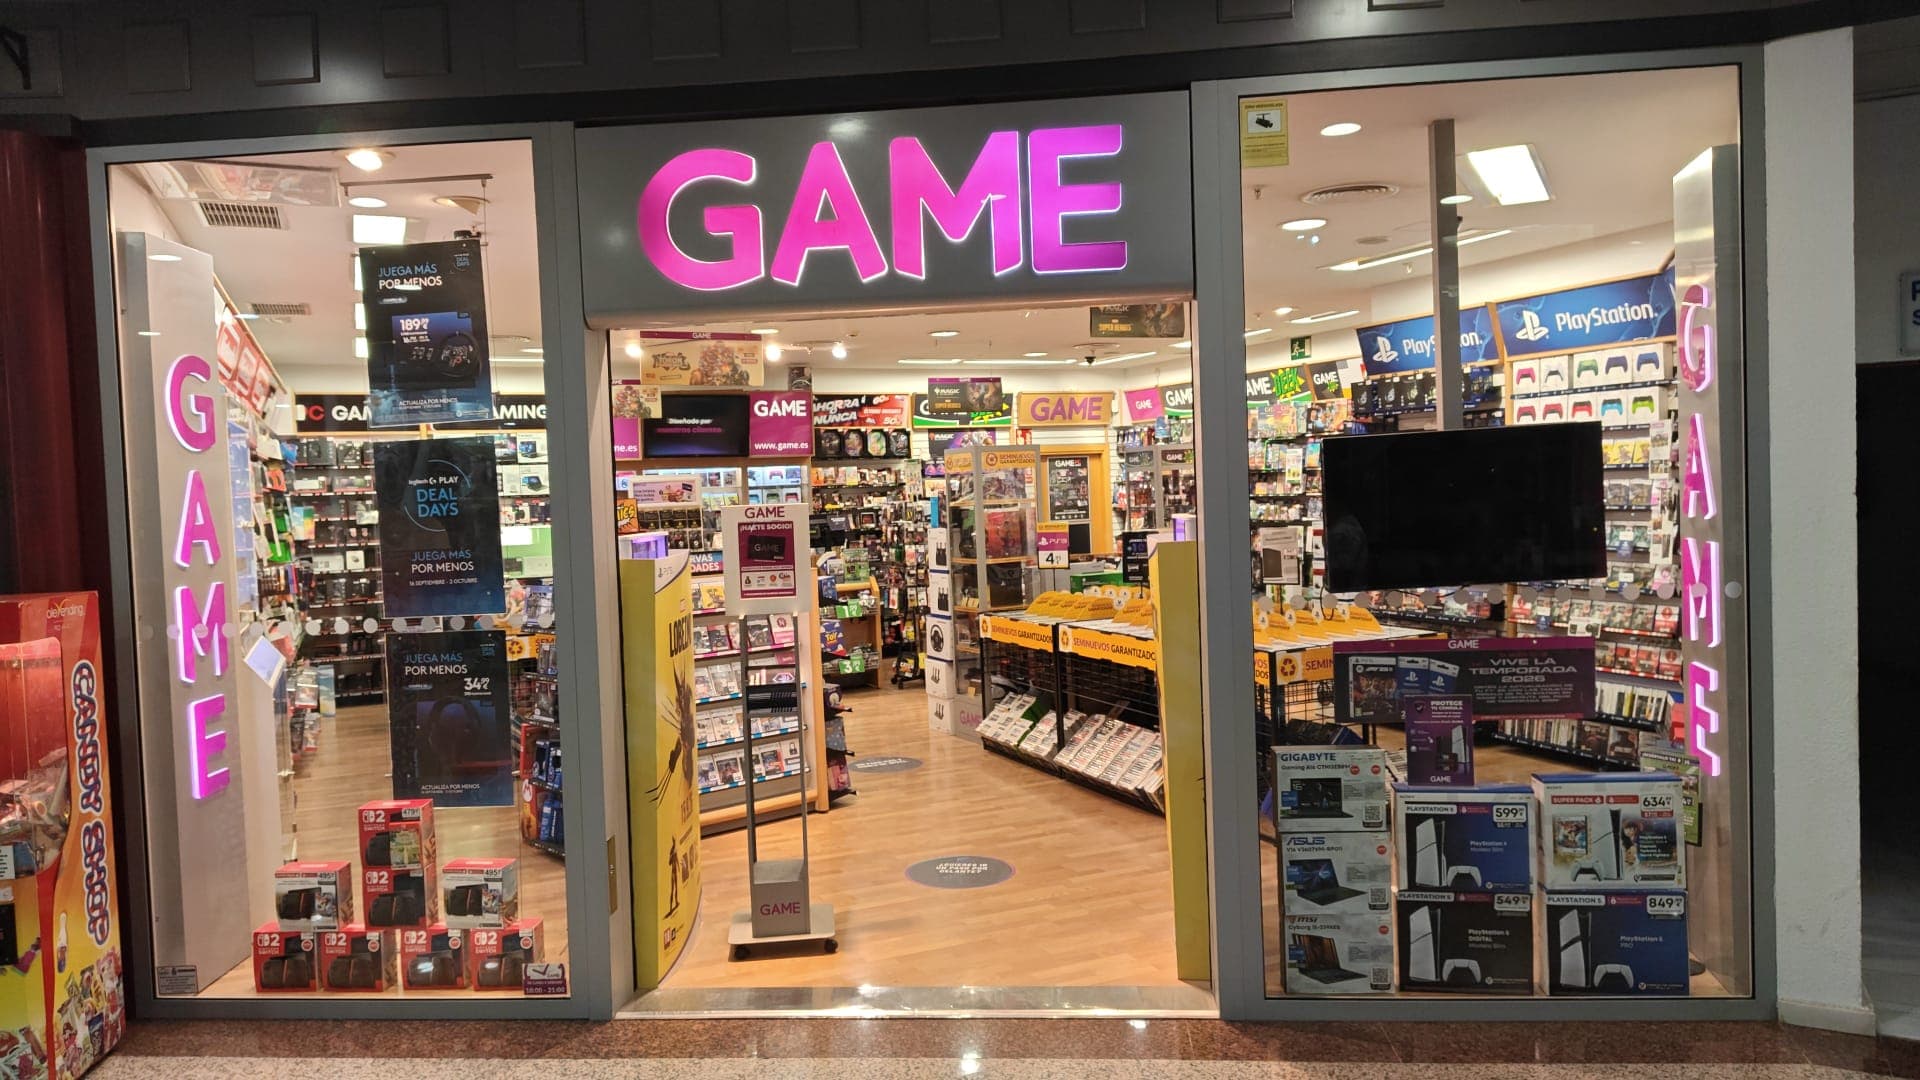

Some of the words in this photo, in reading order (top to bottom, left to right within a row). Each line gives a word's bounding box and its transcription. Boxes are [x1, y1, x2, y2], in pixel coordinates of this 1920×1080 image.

[637, 124, 1128, 291] GAME
[379, 265, 413, 277] JUEGA
[415, 261, 437, 274] MÁS
[403, 276, 443, 289] MENOS
[1313, 371, 1339, 385] GAME
[753, 400, 807, 417] GAME
[1030, 396, 1103, 421] GAME
[1135, 399, 1152, 409] GAME
[814, 411, 858, 425] NUNCA
[754, 441, 809, 451] www.game.es
[1055, 459, 1075, 467] GAME
[438, 476, 459, 485] PLAY
[416, 487, 457, 502] DEAL
[417, 502, 459, 518] DAYS
[744, 506, 785, 519] GAME
[1678, 283, 1721, 777] GAME
[412, 551, 446, 562] JUEGA
[448, 547, 472, 559] MÁS
[754, 543, 780, 553] GAME
[1046, 553, 1055, 564] 4
[411, 563, 434, 574] POR
[436, 561, 474, 572] MENOS
[164, 353, 230, 800] GAME
[454, 577, 478, 585] OCTUBRE
[825, 631, 838, 641] TOY
[1073, 637, 1110, 651] SEMINUEVOS
[1448, 640, 1479, 649] GAME
[404, 653, 439, 664] JUEGA
[440, 650, 463, 662] MÁS
[1489, 658, 1528, 666] VIVE
[1534, 657, 1557, 665] LA
[405, 666, 427, 676] POR
[429, 664, 468, 675] MENOS
[1468, 665, 1578, 675] TEMPORADA
[1501, 674, 1546, 683] 2026
[72, 659, 105, 814] CANDY
[1280, 752, 1337, 762] GIGABYTE
[1281, 764, 1305, 772] Gaming
[1430, 775, 1452, 783] GAME
[1642, 796, 1666, 807] 634
[377, 810, 386, 823] 2
[1495, 807, 1518, 818] 599
[1286, 837, 1326, 846] ASUS
[81, 819, 111, 948] SHOP
[380, 871, 389, 884] 2
[1495, 896, 1520, 905] 549
[1649, 898, 1673, 908] 849
[760, 902, 801, 917] GAME
[270, 933, 281, 947] 2
[337, 933, 347, 946] 2
[418, 931, 428, 945] 2
[487, 931, 498, 945] 2
